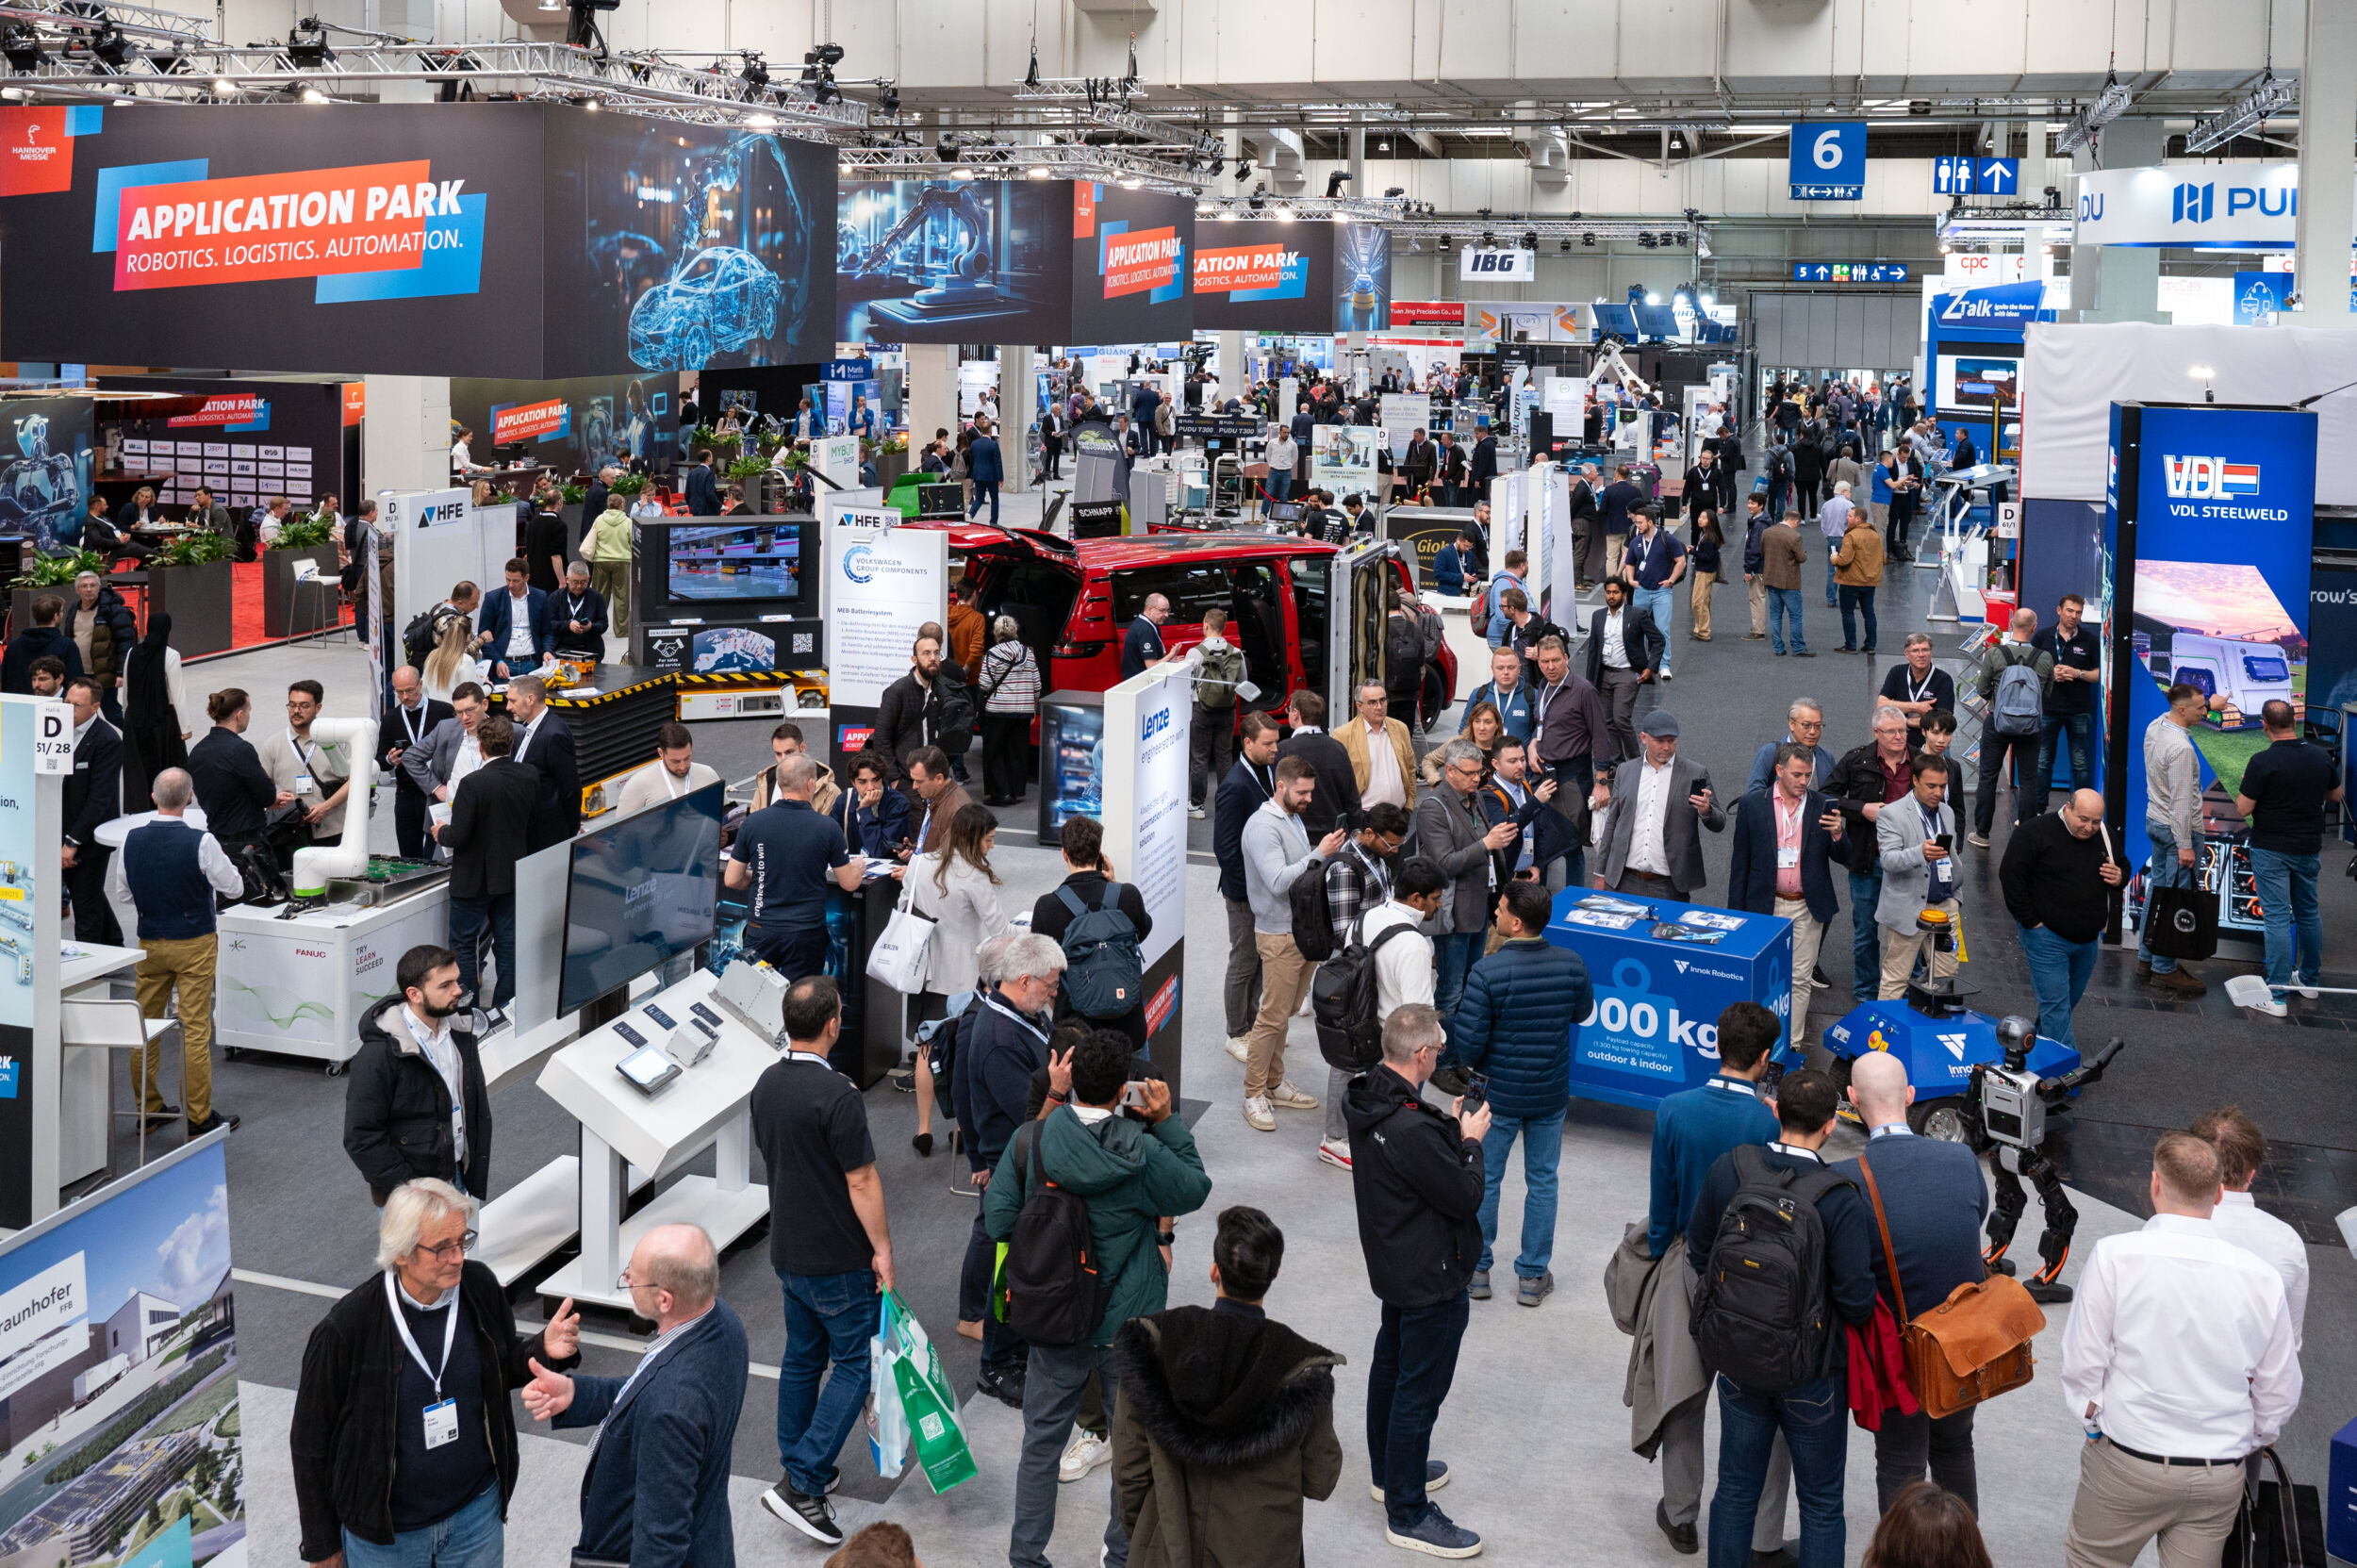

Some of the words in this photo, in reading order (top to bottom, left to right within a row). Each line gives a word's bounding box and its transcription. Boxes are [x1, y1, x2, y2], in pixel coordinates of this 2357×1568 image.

[1813, 129, 1842, 170] 6
[127, 189, 354, 241] APPLICATION
[366, 179, 466, 222] PARK
[2078, 193, 2103, 223] DU
[2228, 188, 2298, 217] PU
[127, 248, 218, 273] ROBOTICS.
[224, 239, 320, 266] LOGISTICS.
[325, 228, 463, 257] AUTOMATION.
[1108, 241, 1160, 269] APPLICATION
[1161, 237, 1181, 258] PARK
[1253, 251, 1299, 269] PARK
[1472, 254, 1515, 272] IBG
[1960, 256, 1988, 274] cpc
[1107, 272, 1129, 288] ROBOTICS.
[1130, 268, 1152, 284] LOGISTICS.
[1152, 263, 1180, 280] AUTOMATION.
[1234, 271, 1298, 285] AUTOMATION.
[1800, 268, 1806, 277] 5
[1605, 314, 1624, 325] IBG
[1646, 314, 1666, 325] IBG
[1618, 367, 1628, 377] IBG
[238, 398, 266, 410] PARK
[171, 413, 198, 423] ROBOTICS.
[198, 412, 226, 422] LOGISTICS.
[227, 411, 265, 421] AUTOMATION.
[497, 409, 547, 430] APPLICATION
[548, 403, 568, 416] PARK
[497, 428, 519, 439] ROBOTICS.
[519, 423, 539, 435] LOGISTICS.
[389, 503, 397, 514] D
[437, 502, 463, 521] HFE
[1079, 506, 1113, 518] SCHNAPP
[2003, 509, 2014, 520] D
[2170, 503, 2199, 518] VDL
[2201, 505, 2288, 521] STEELWELD
[855, 515, 880, 528] HFE
[856, 557, 902, 567] VOLKSWAGEN
[856, 565, 880, 573] GROUP
[881, 566, 928, 575] COMPONENTS
[836, 607, 893, 617] MEB-Batteriesystem
[43, 716, 62, 738] D
[1142, 706, 1170, 741] Lenze
[36, 742, 54, 755] 51/
[56, 743, 71, 754] 28
[1141, 735, 1169, 764] engineered
[1175, 728, 1184, 742] win
[1139, 810, 1162, 833] automation
[1139, 831, 1156, 850] solution
[758, 860, 766, 870] to
[625, 877, 657, 904] Lenze
[754, 870, 766, 917] engineered
[295, 949, 326, 959] FANUC
[356, 945, 368, 956] TRY
[356, 950, 377, 966] LEARN
[356, 957, 384, 976] SUCCEED
[1690, 965, 1711, 976] Innok
[1711, 968, 1744, 982] Robotics
[1164, 975, 1178, 999] PARK
[1778, 991, 1790, 1018] kg
[1606, 1035, 1629, 1046] Payload
[1630, 1040, 1655, 1050] capacity
[1587, 1049, 1628, 1065] outdoor
[1630, 1058, 1638, 1066] &
[1640, 1058, 1673, 1073] indoor
[1621, 1046, 1640, 1055] towing
[1640, 1049, 1668, 1060] capacity)
[59, 1300, 74, 1313] FFB
